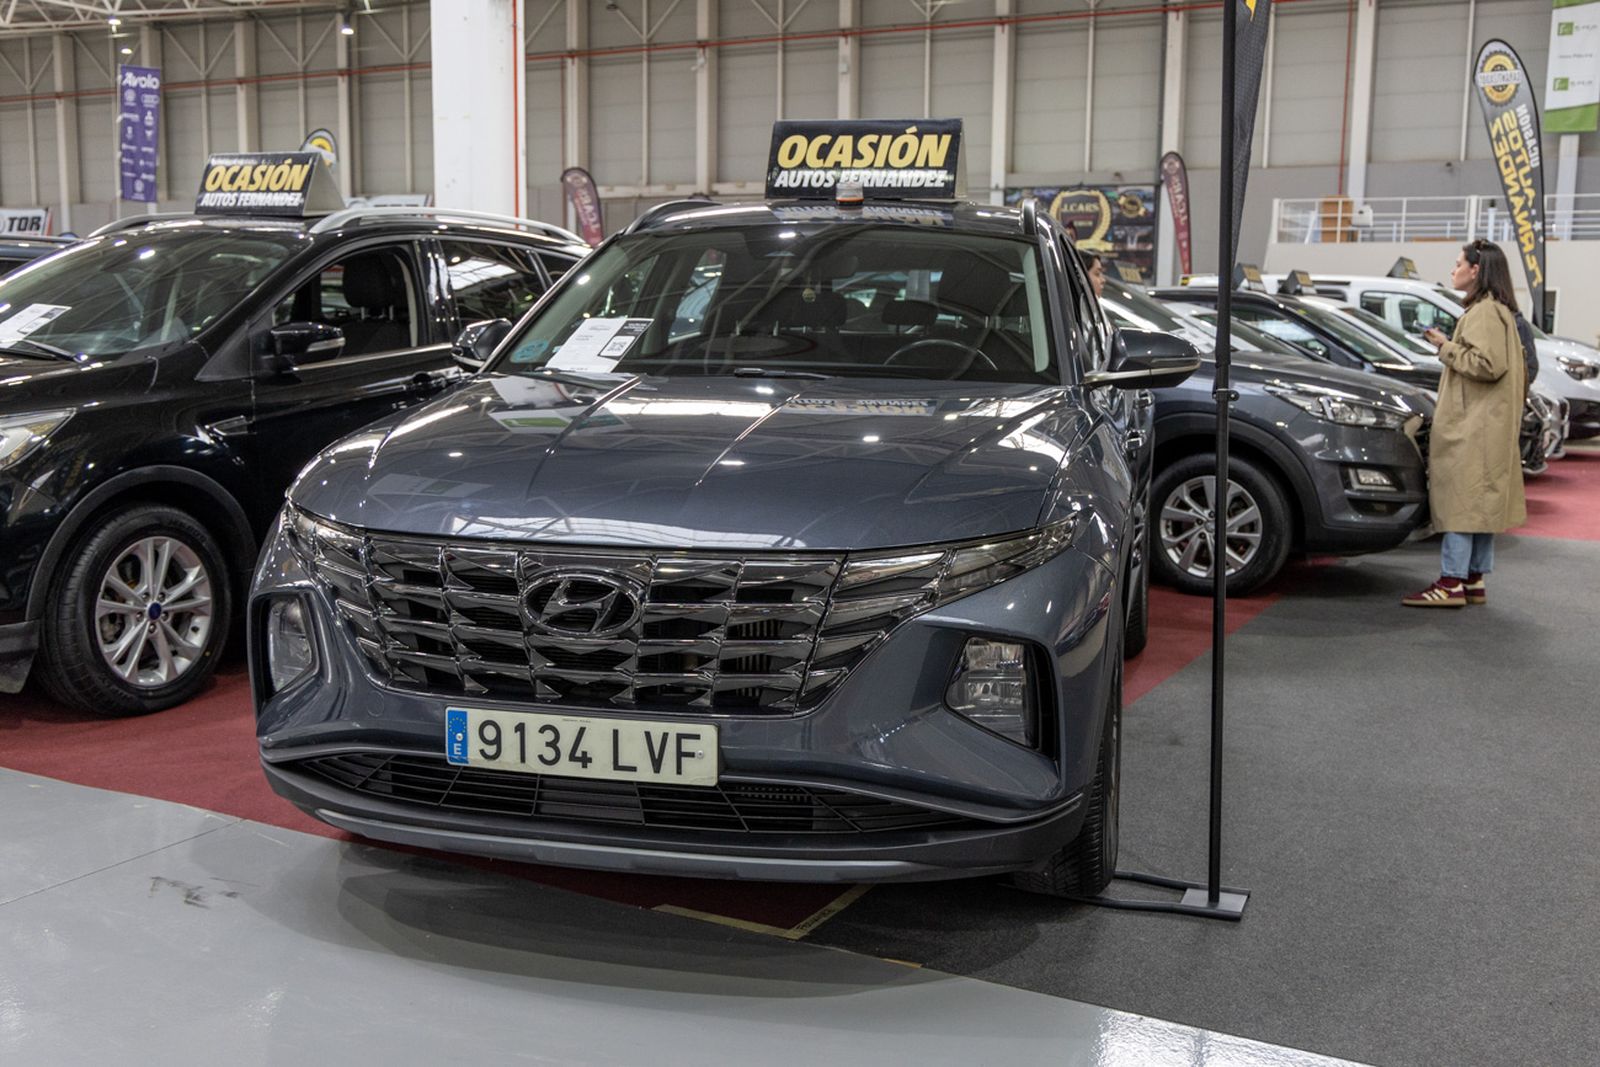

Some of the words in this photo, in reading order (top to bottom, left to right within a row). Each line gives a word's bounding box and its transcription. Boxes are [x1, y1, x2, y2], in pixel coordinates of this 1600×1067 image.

[777, 126, 952, 169] OCASIÓN
[204, 158, 310, 192] OCASIÓN
[774, 170, 837, 188] AUTOS
[200, 192, 238, 207] AUTOS
[453, 743, 463, 755] E
[477, 719, 593, 769] 9134
[612, 728, 702, 776] LVF
